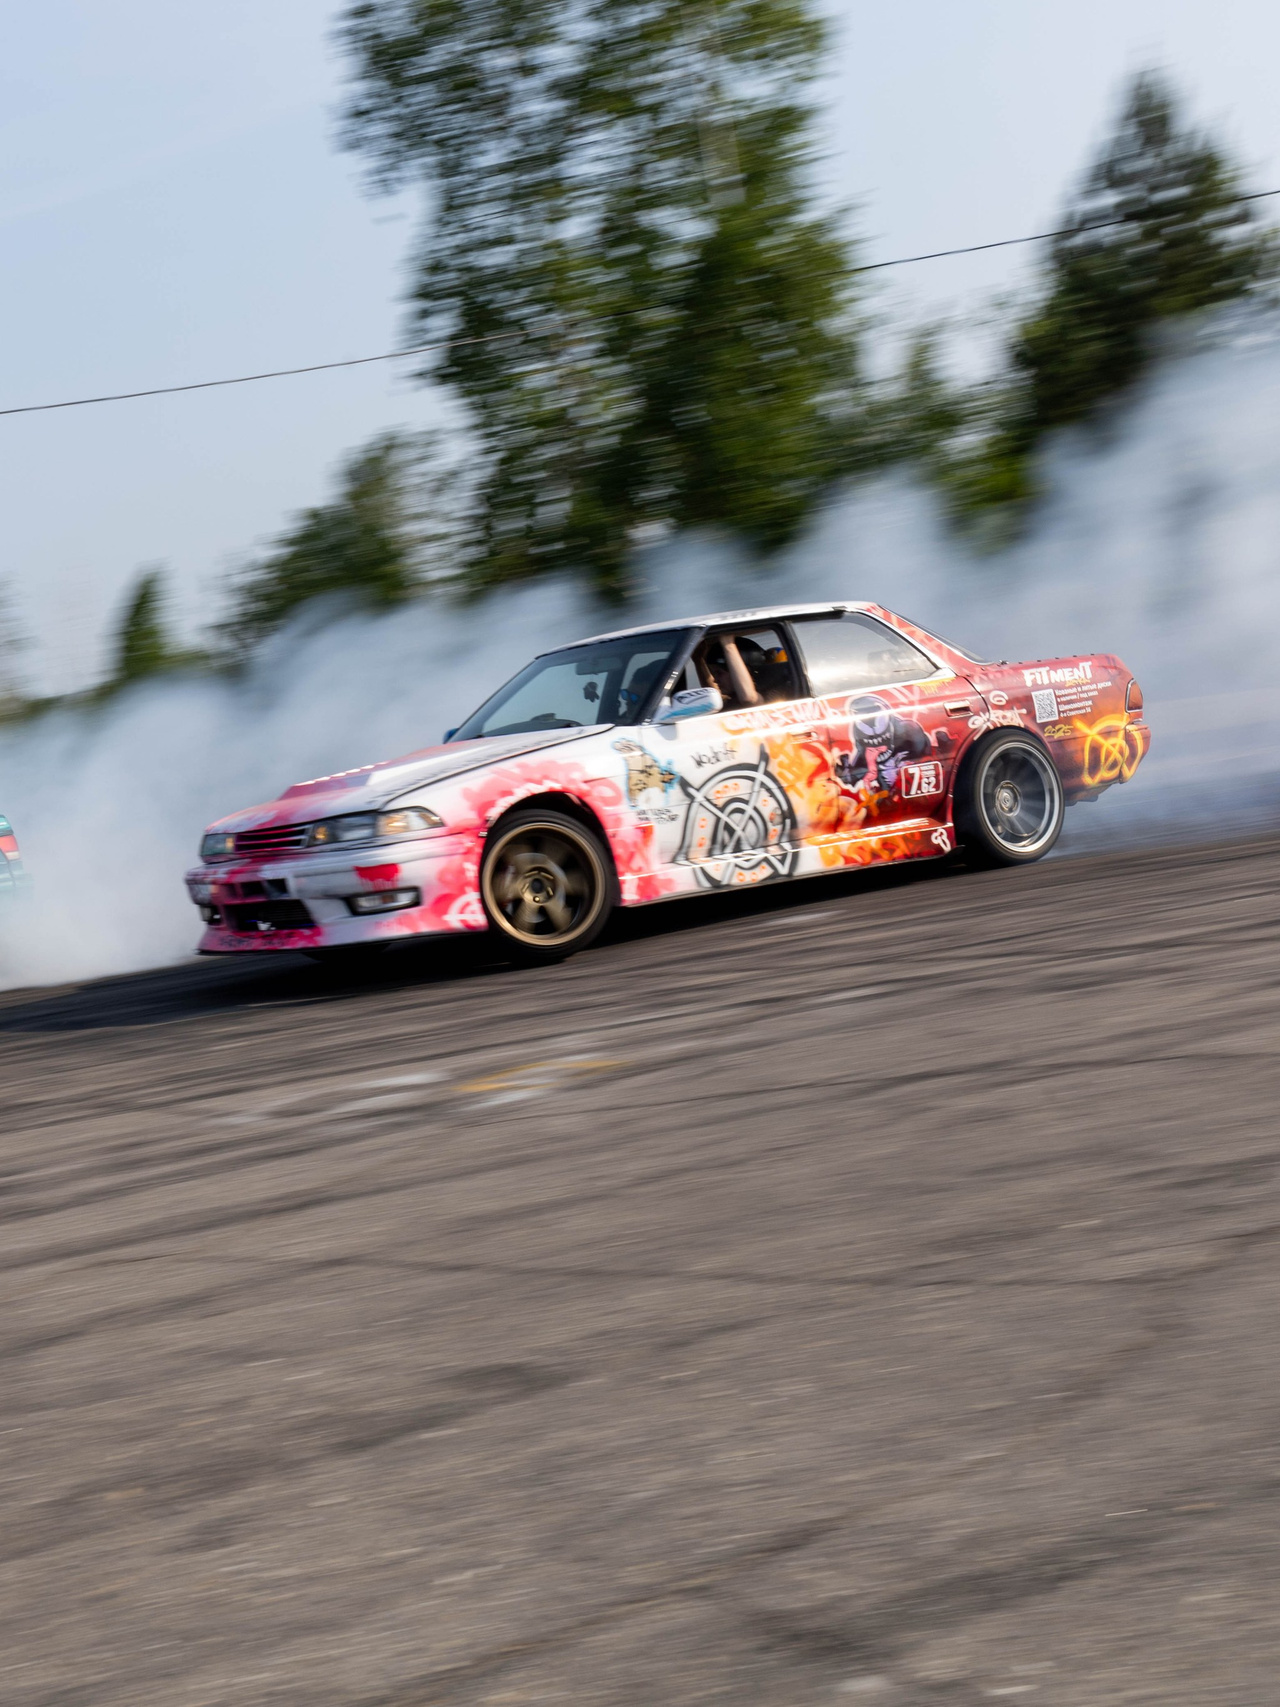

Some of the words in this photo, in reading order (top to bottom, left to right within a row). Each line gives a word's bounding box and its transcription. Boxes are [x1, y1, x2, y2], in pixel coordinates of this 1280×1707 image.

[1097, 681, 1112, 690] диски
[1058, 700, 1093, 711] Шиномонтаж
[1044, 724, 1074, 739] 2025
